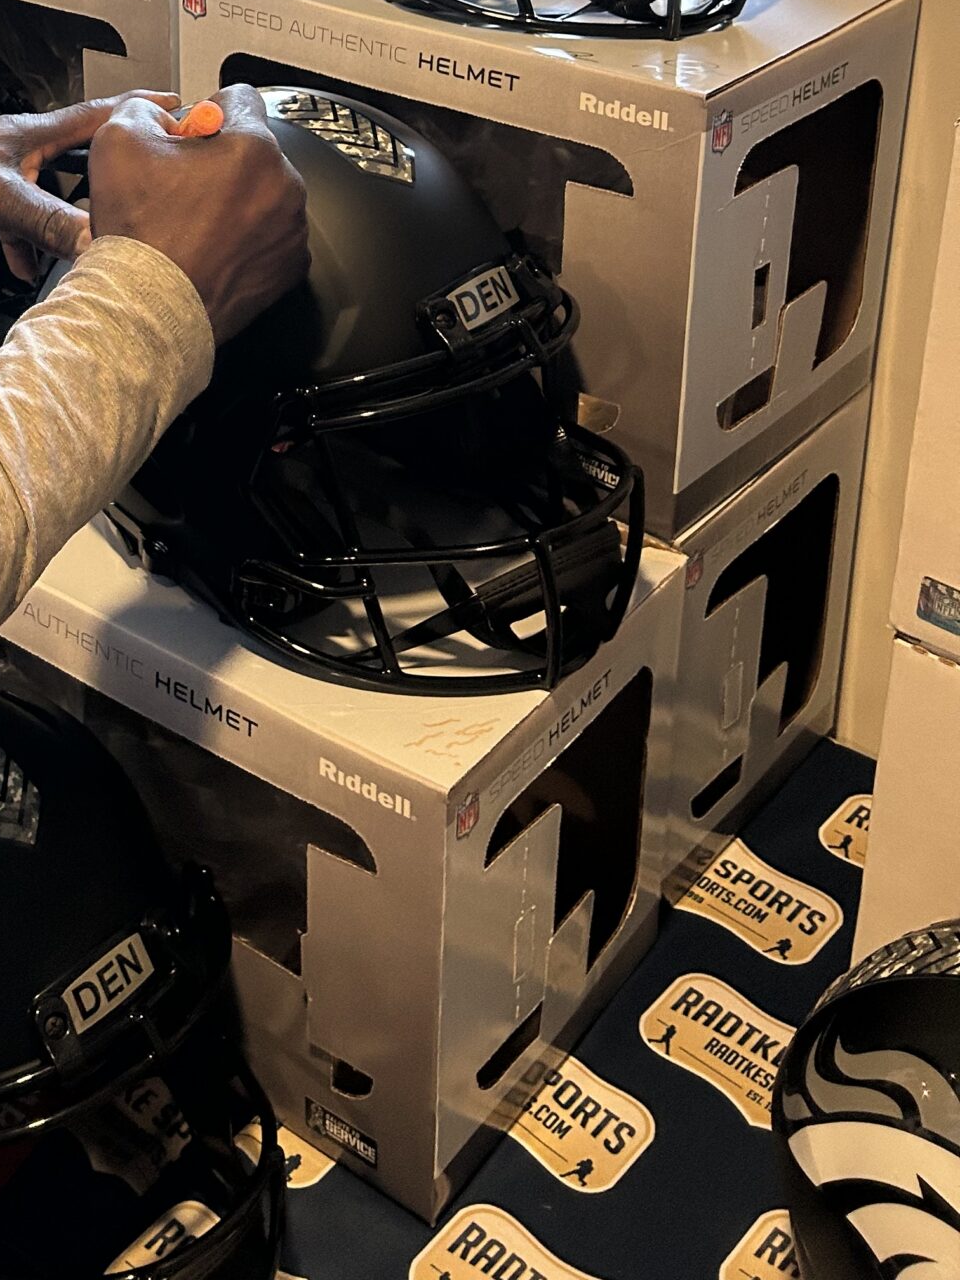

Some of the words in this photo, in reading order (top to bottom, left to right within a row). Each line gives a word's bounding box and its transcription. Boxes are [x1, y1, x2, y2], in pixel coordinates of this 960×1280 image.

[218, 1, 283, 31] SPEED
[289, 19, 408, 65] AUTHENTIC
[418, 52, 520, 91] HELMET
[579, 91, 670, 132] Riddell
[740, 94, 789, 134] SPEED
[792, 61, 849, 107] HELMET
[455, 270, 512, 324] DEN
[757, 468, 809, 521] HELMET
[22, 602, 143, 679] AUTHENTIC
[155, 671, 259, 737] HELMET
[490, 738, 545, 804] SPEED
[548, 669, 612, 747] HELMET
[319, 756, 411, 819] Riddell
[713, 859, 827, 936] SPORTS
[71, 942, 144, 1021] DEN
[325, 1119, 377, 1158] SERVICE
